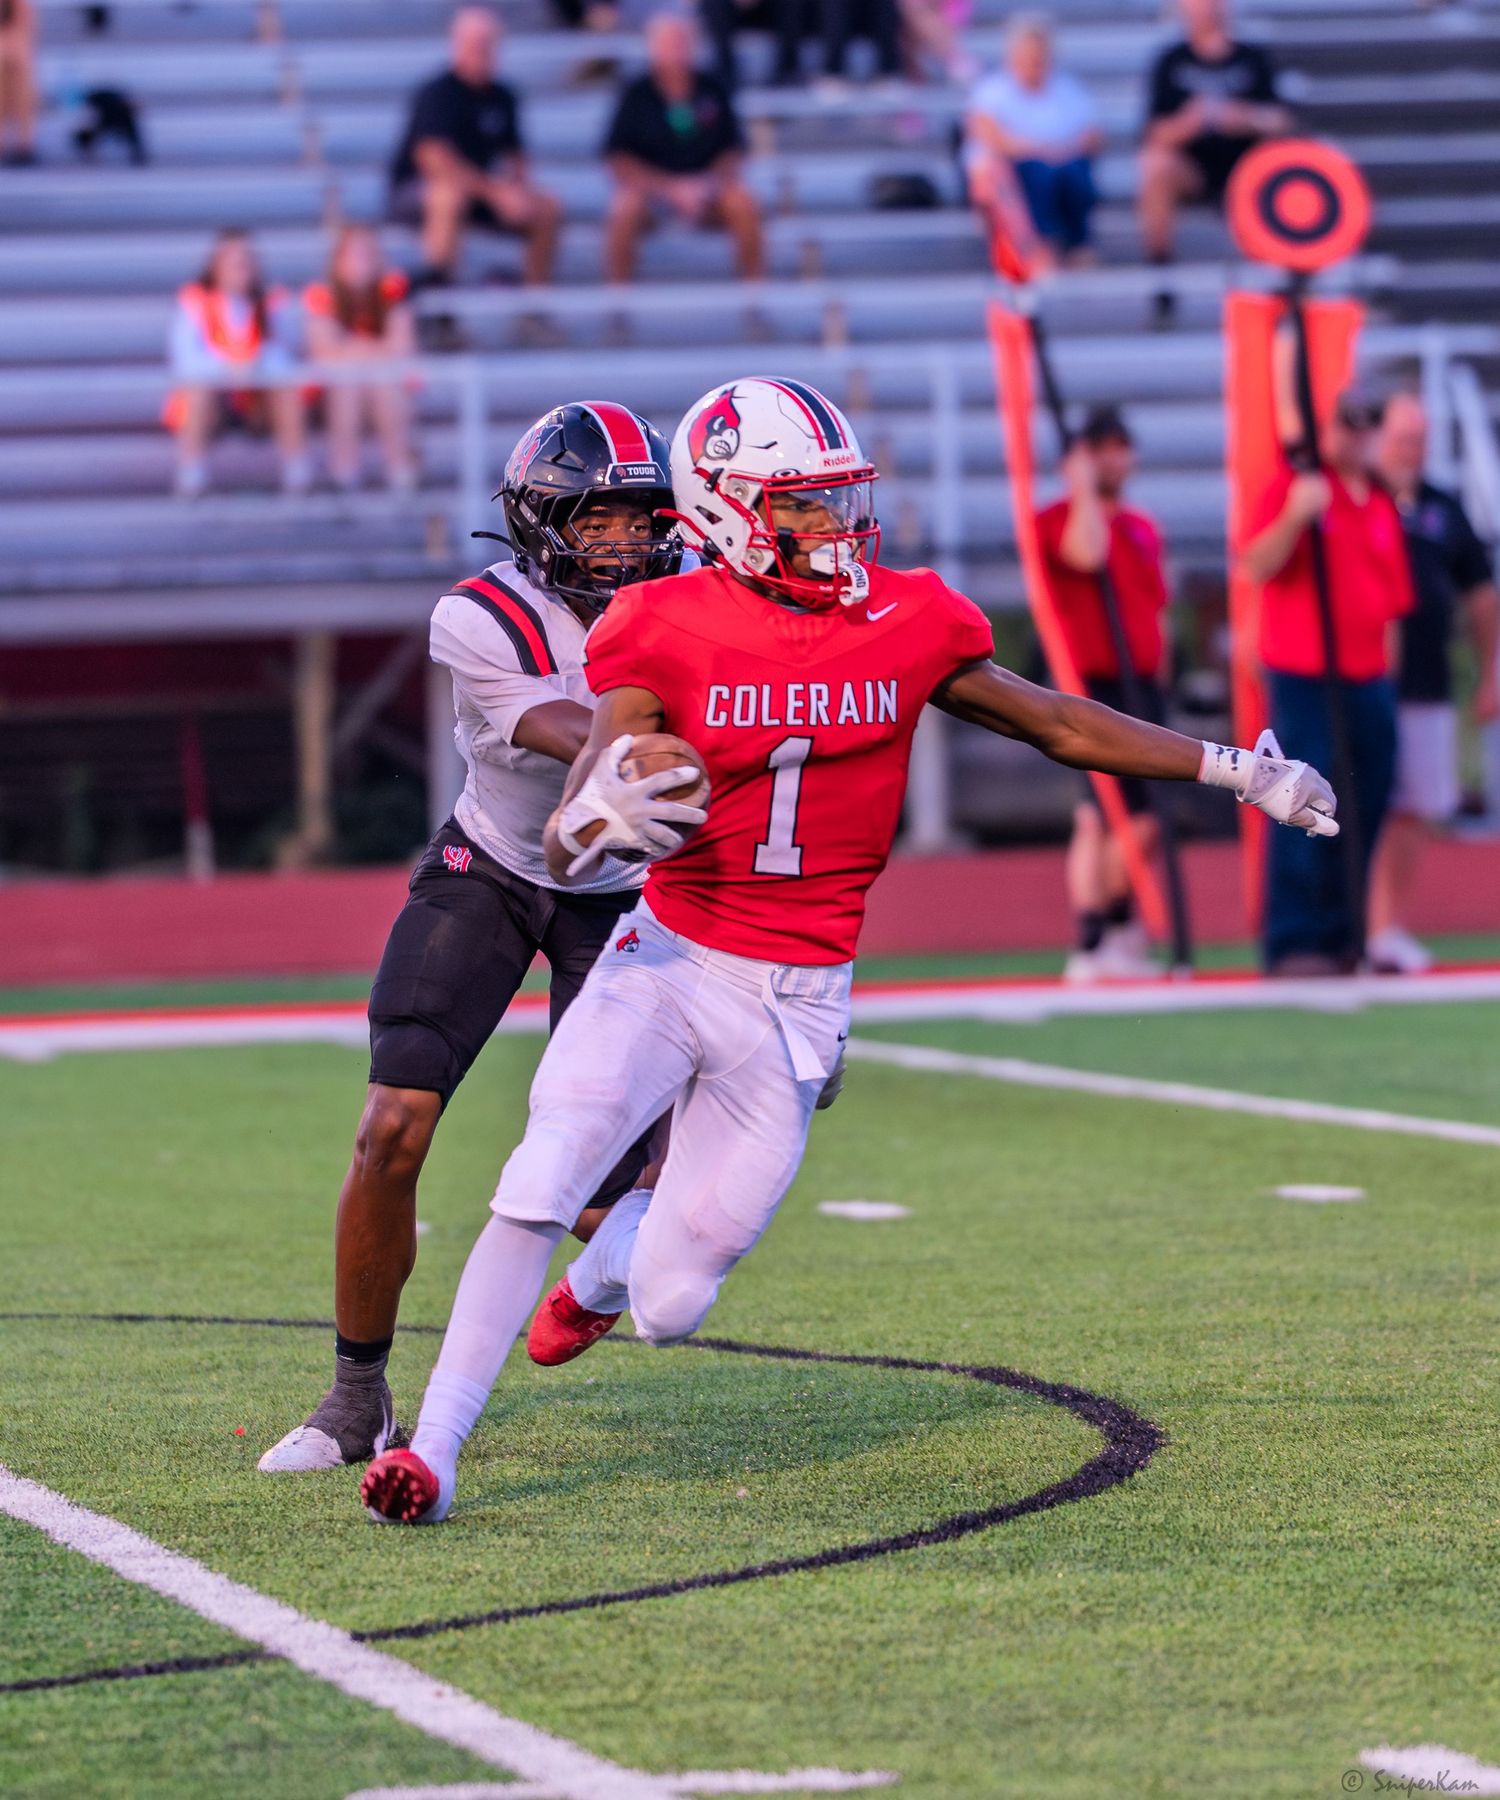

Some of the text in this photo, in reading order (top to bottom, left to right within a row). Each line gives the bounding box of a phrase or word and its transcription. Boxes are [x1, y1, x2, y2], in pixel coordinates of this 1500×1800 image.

[626, 466, 656, 476] TOUGH
[823, 453, 856, 467] Riddell
[705, 679, 898, 727] COLERAIN
[752, 735, 814, 878] 1
